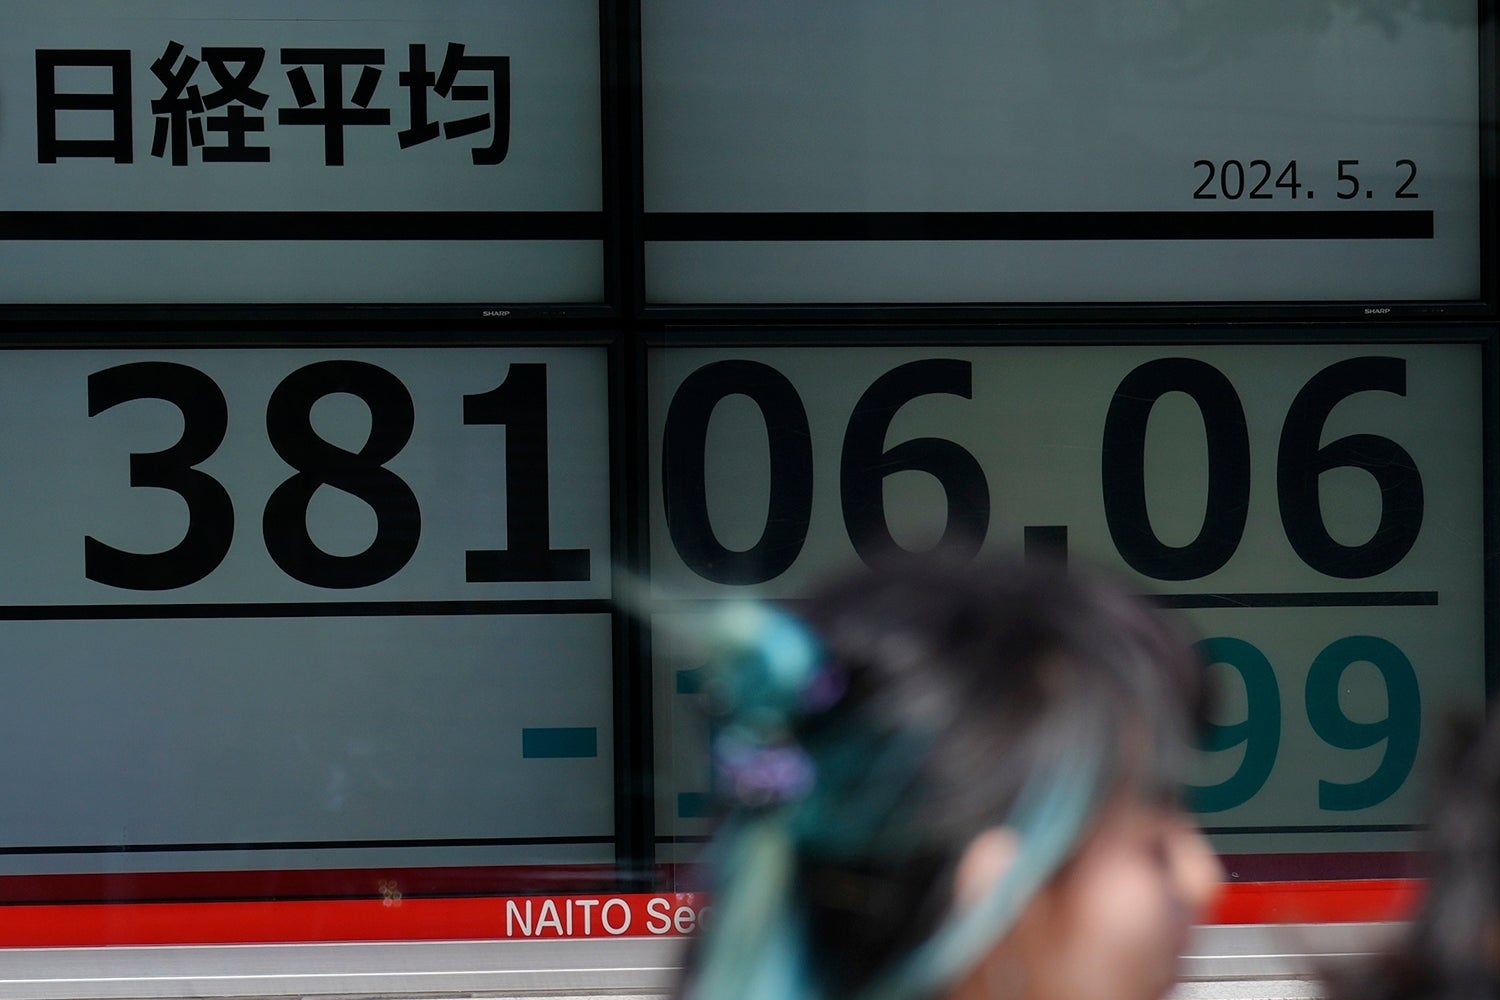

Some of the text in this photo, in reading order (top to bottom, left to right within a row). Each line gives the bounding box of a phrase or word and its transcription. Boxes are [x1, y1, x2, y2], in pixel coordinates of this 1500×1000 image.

[35, 40, 511, 167] 日経平均
[506, 898, 631, 936] NAITO
